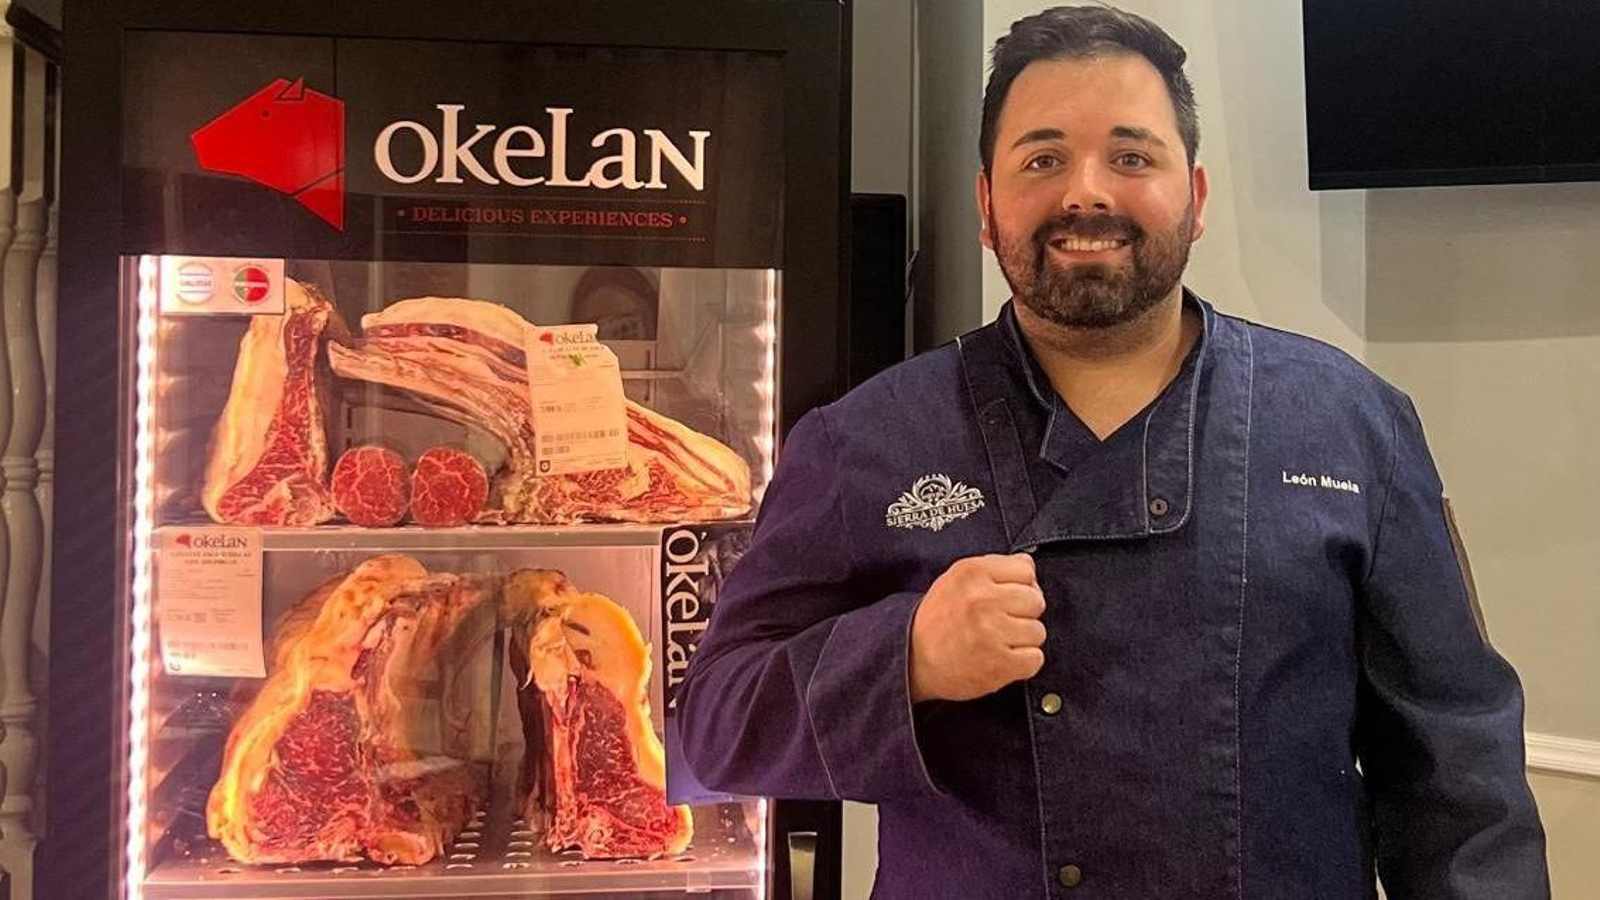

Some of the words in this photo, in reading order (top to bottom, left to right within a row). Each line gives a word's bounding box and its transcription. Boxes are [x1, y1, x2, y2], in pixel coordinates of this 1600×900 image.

[412, 207, 523, 222] DELICIOUS
[530, 209, 673, 227] EXPERIENCES
[1282, 471, 1317, 487] León
[1320, 475, 1360, 493] Muela
[886, 510, 928, 527] SIERRA
[929, 507, 945, 517] DE
